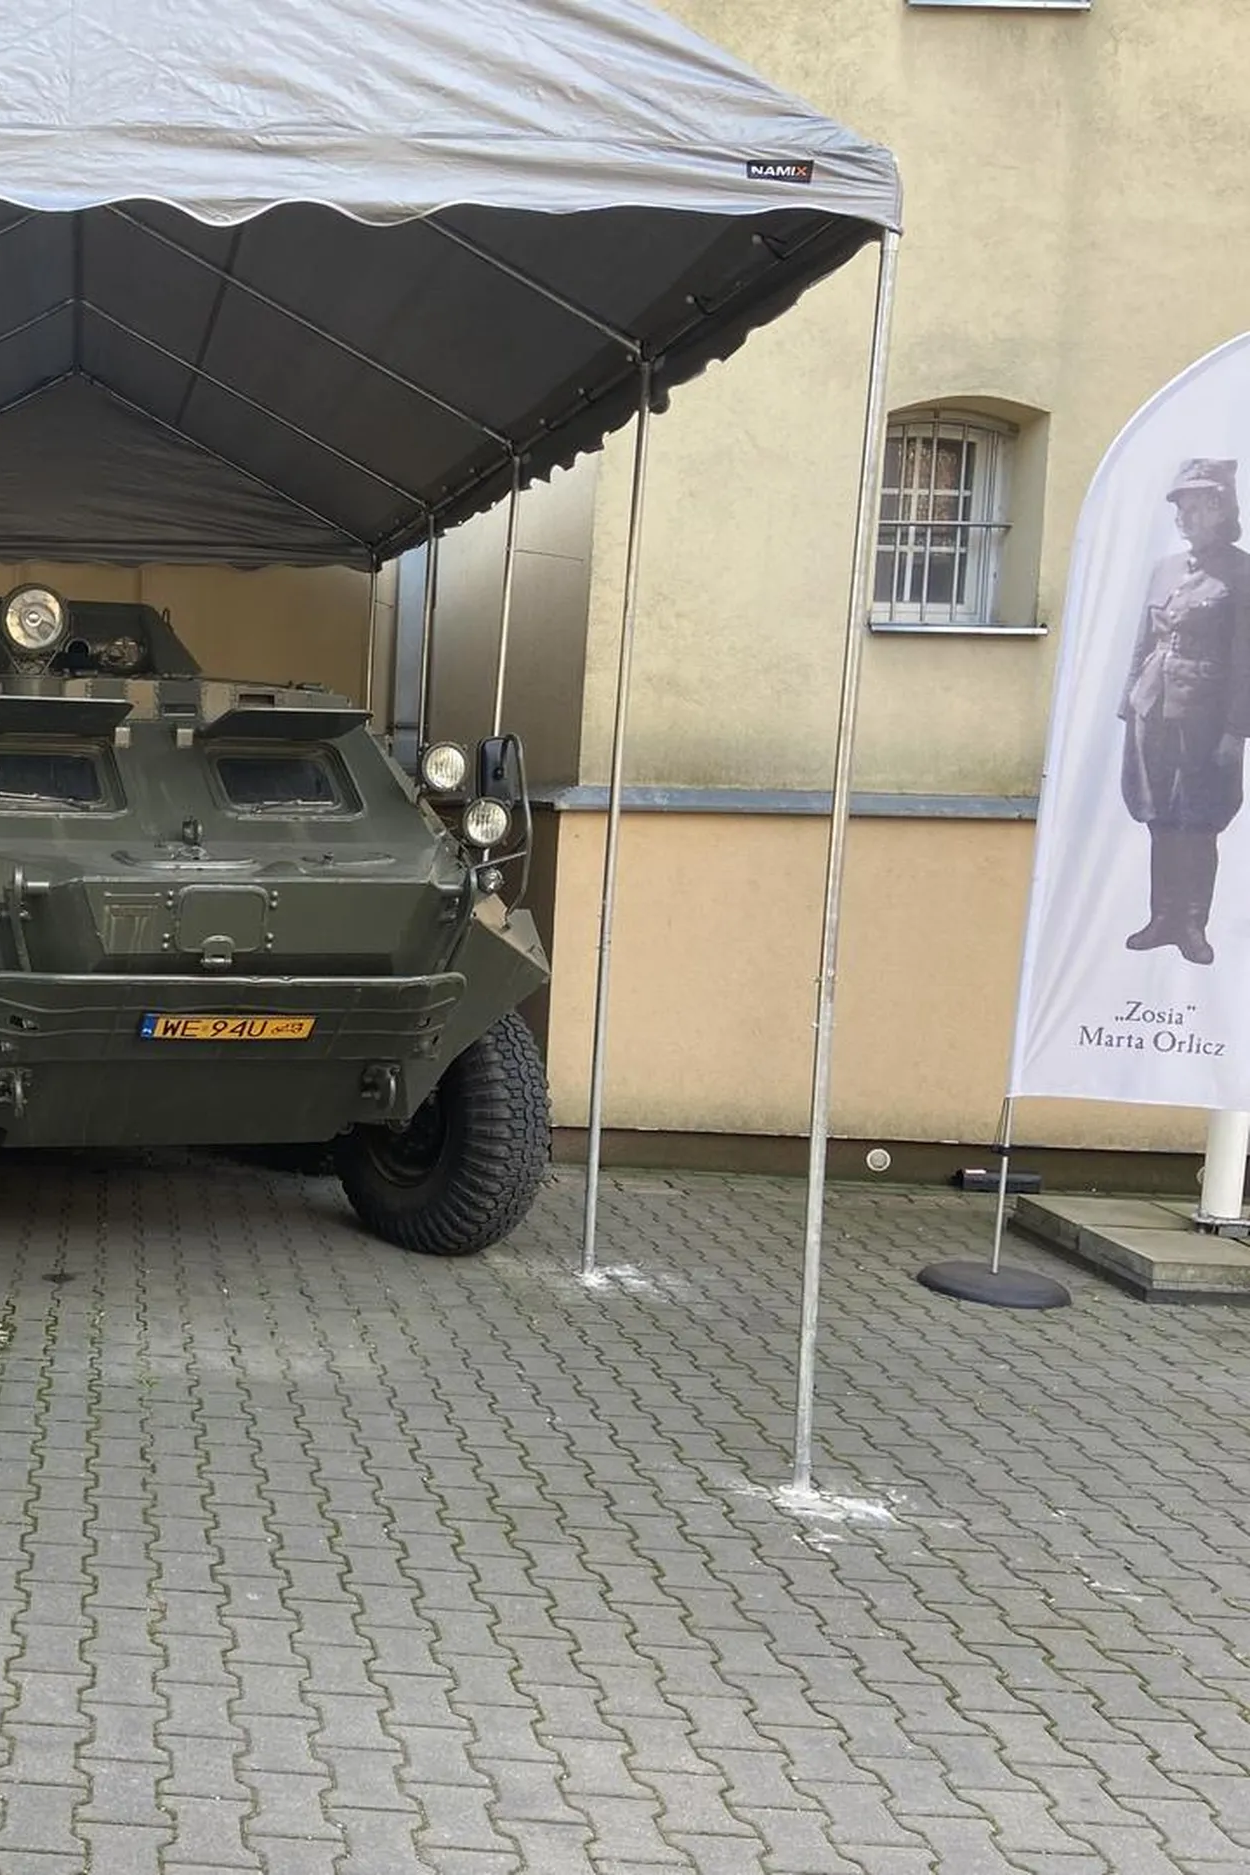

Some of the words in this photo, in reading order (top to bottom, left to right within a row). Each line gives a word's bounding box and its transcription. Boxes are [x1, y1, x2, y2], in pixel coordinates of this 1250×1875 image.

[750, 165, 808, 177] NAMIX
[161, 1019, 203, 1037] WE
[209, 1019, 269, 1037] 94U
[1078, 1025, 1145, 1050] Marta
[1152, 1030, 1226, 1057] Orlicz
